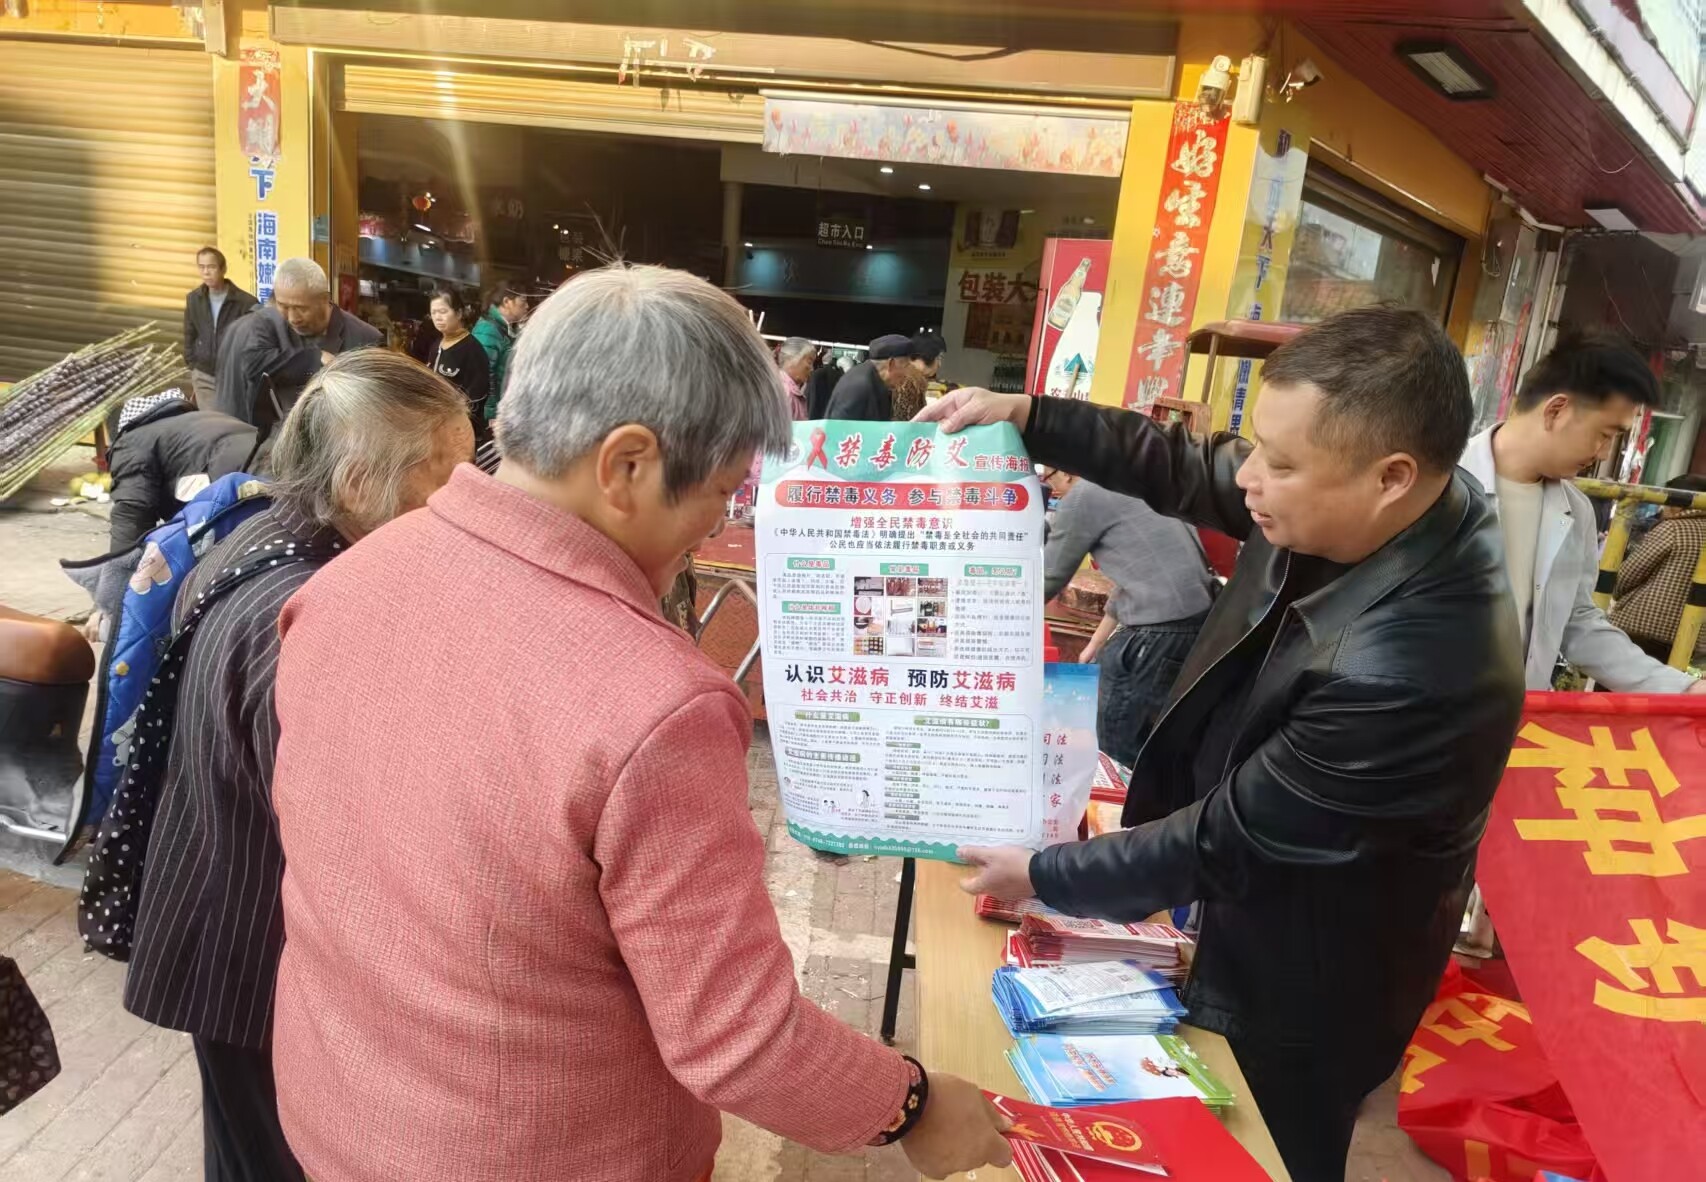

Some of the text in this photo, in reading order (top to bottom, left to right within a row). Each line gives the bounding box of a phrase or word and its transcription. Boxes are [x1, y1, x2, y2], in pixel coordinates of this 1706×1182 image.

[817, 221, 865, 240] 超市入口
[835, 433, 1031, 473] 禁毒防艾 宣传海报
[786, 485, 1018, 507] 履行禁毒义务 参与禁毒斗争
[850, 516, 954, 530] 增强全民禁毒意识
[785, 664, 1017, 693] 认识艾滋病 预防艾滋病
[800, 688, 999, 710] 社会共治 守正创新 终结艾滋
